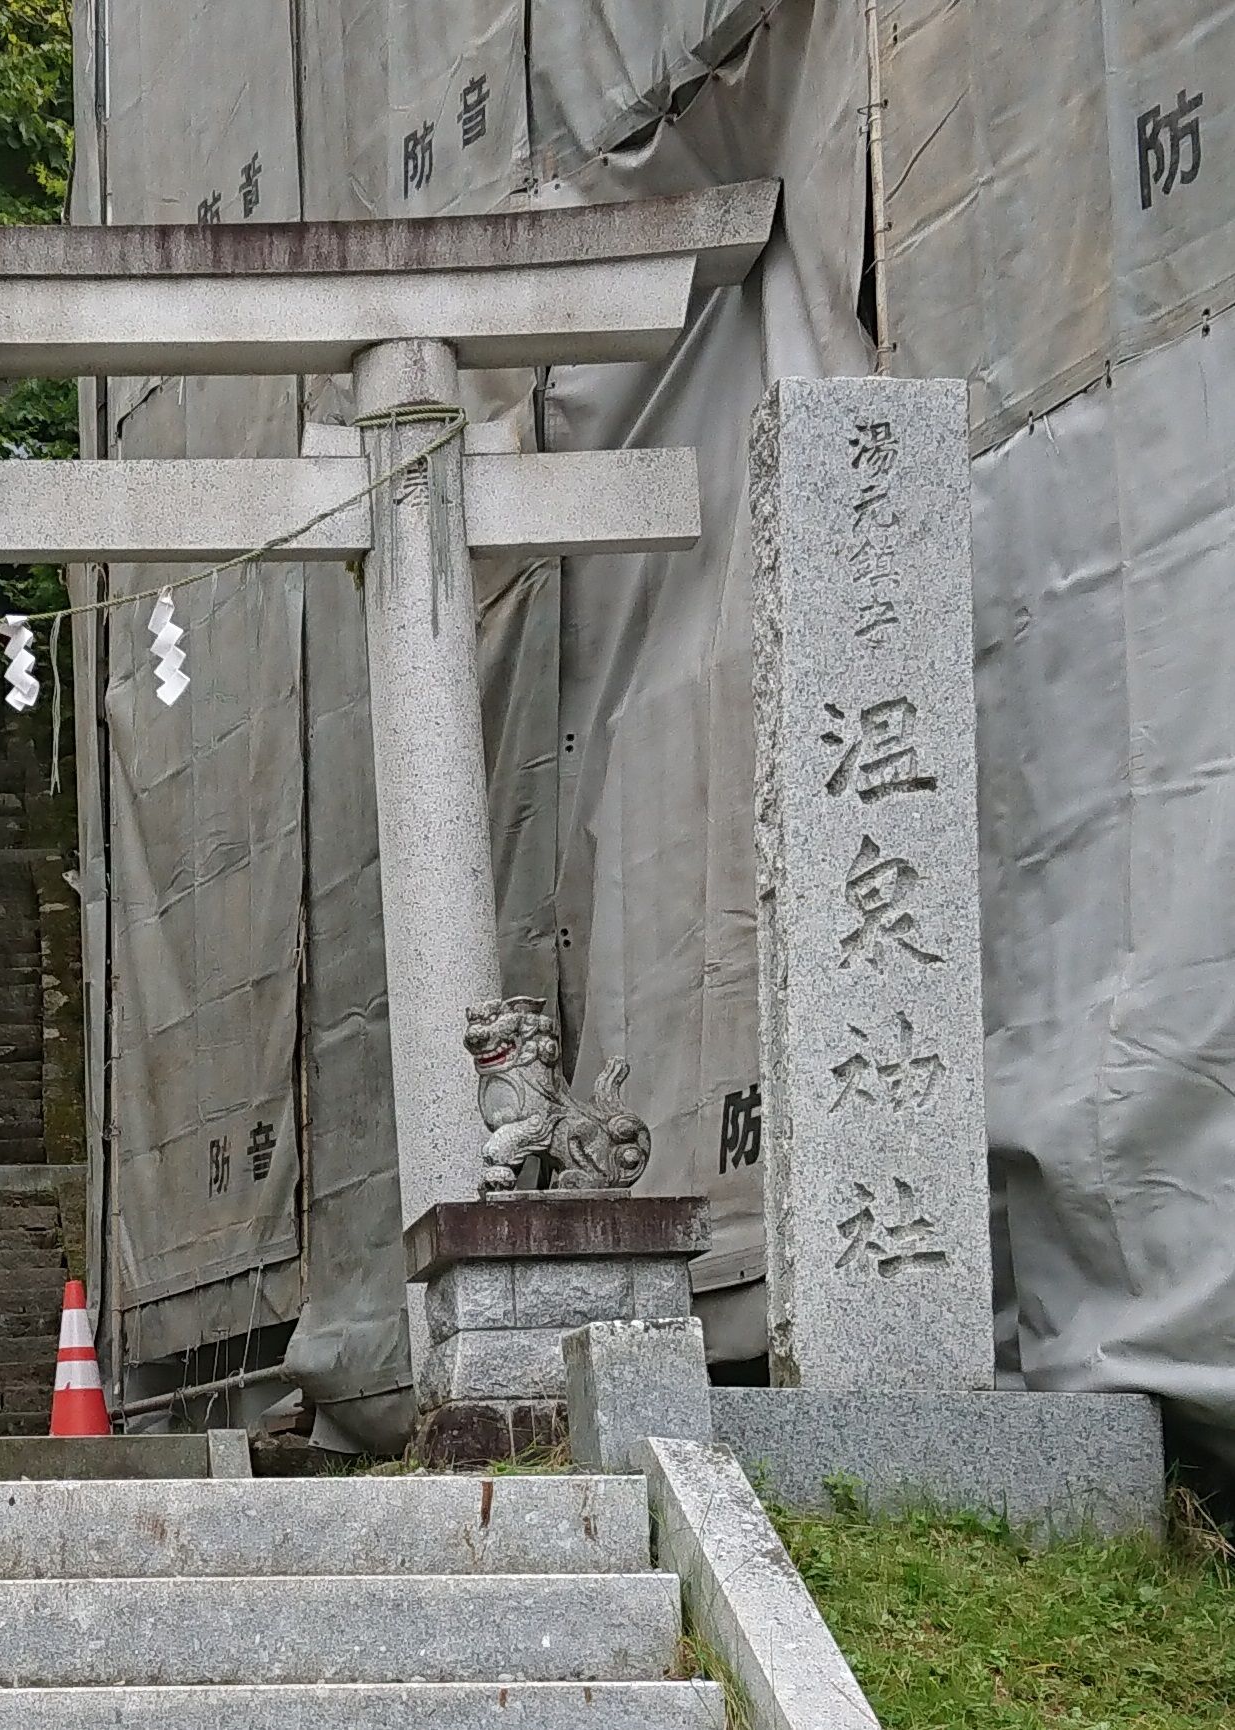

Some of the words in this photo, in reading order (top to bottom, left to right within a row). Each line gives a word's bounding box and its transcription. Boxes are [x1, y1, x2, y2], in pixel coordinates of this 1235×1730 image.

[403, 73, 488, 200] 防音
[1137, 88, 1204, 211] 防
[823, 695, 953, 1280] 温泉神社
[209, 1121, 278, 1198] 防音
